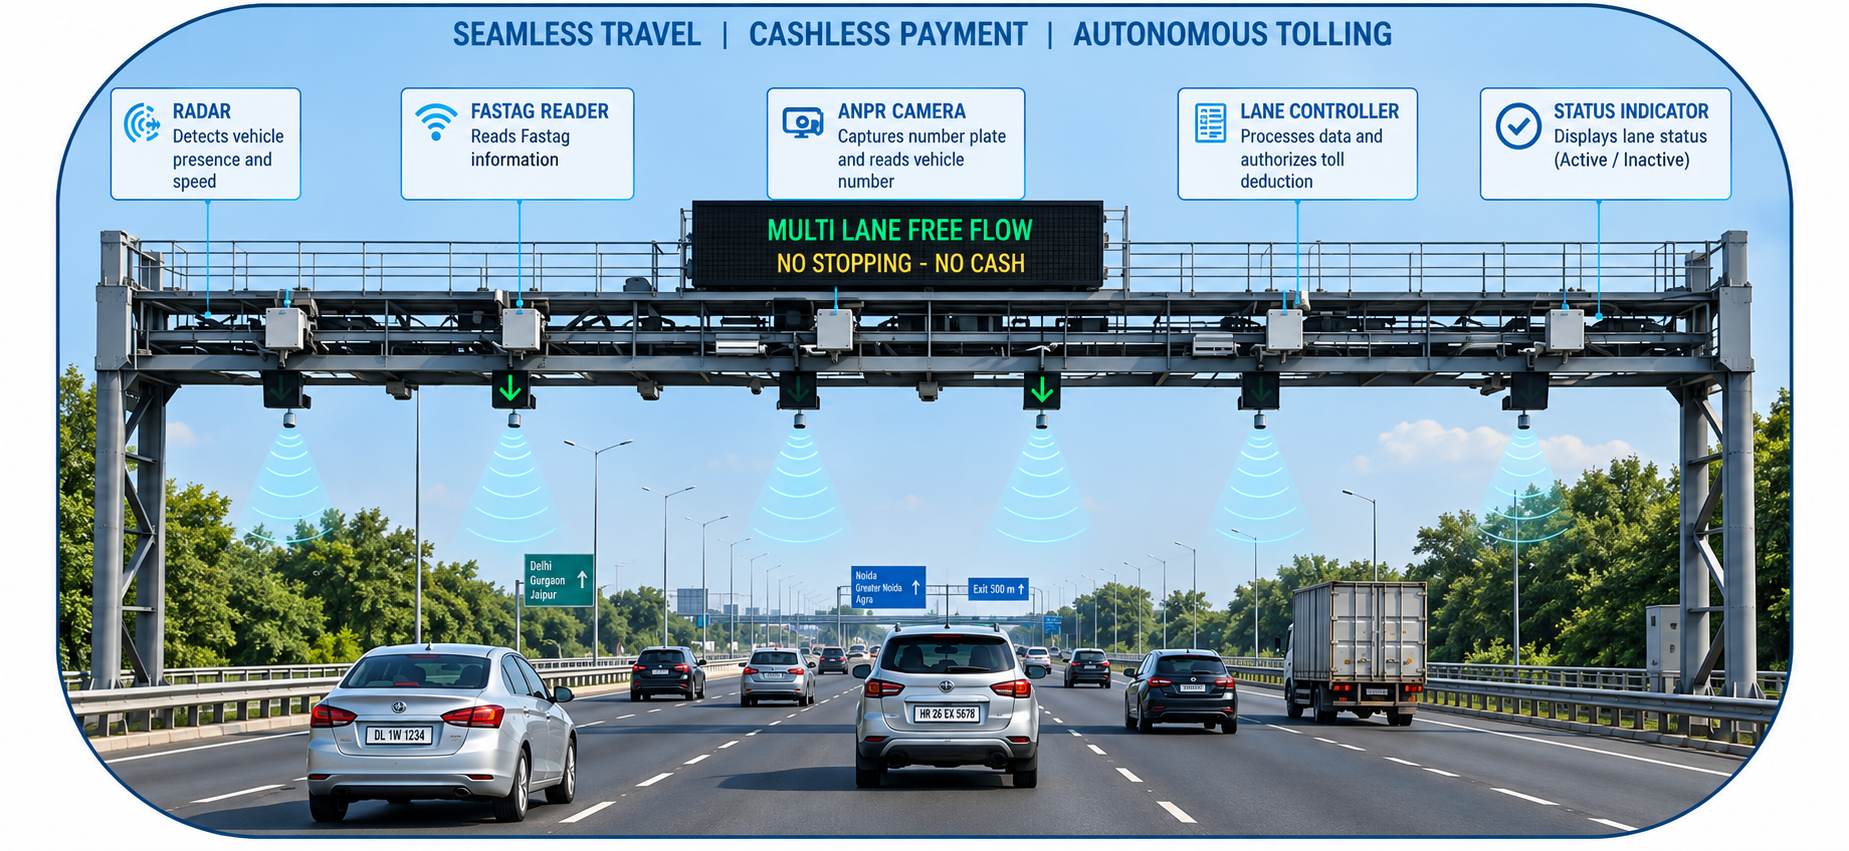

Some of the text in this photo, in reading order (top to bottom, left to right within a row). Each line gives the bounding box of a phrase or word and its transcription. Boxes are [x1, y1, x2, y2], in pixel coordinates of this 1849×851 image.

[768, 218, 1033, 242] MULTI LANE FREE FLOW
[777, 252, 806, 273] NO
[812, 252, 912, 274] STOPPING
[935, 252, 964, 273] NO
[970, 252, 1025, 273] CASH
[530, 560, 552, 571] Delhi
[530, 575, 566, 588] Gurgaon
[855, 570, 878, 581] Noida
[882, 583, 903, 592] Noida
[973, 583, 1015, 594] Exit 500 m
[530, 589, 557, 602] Jaipur
[855, 594, 874, 606] Agra
[920, 708, 976, 719] HR 26 EX 5678
[374, 729, 425, 741] DL 1W 1234
